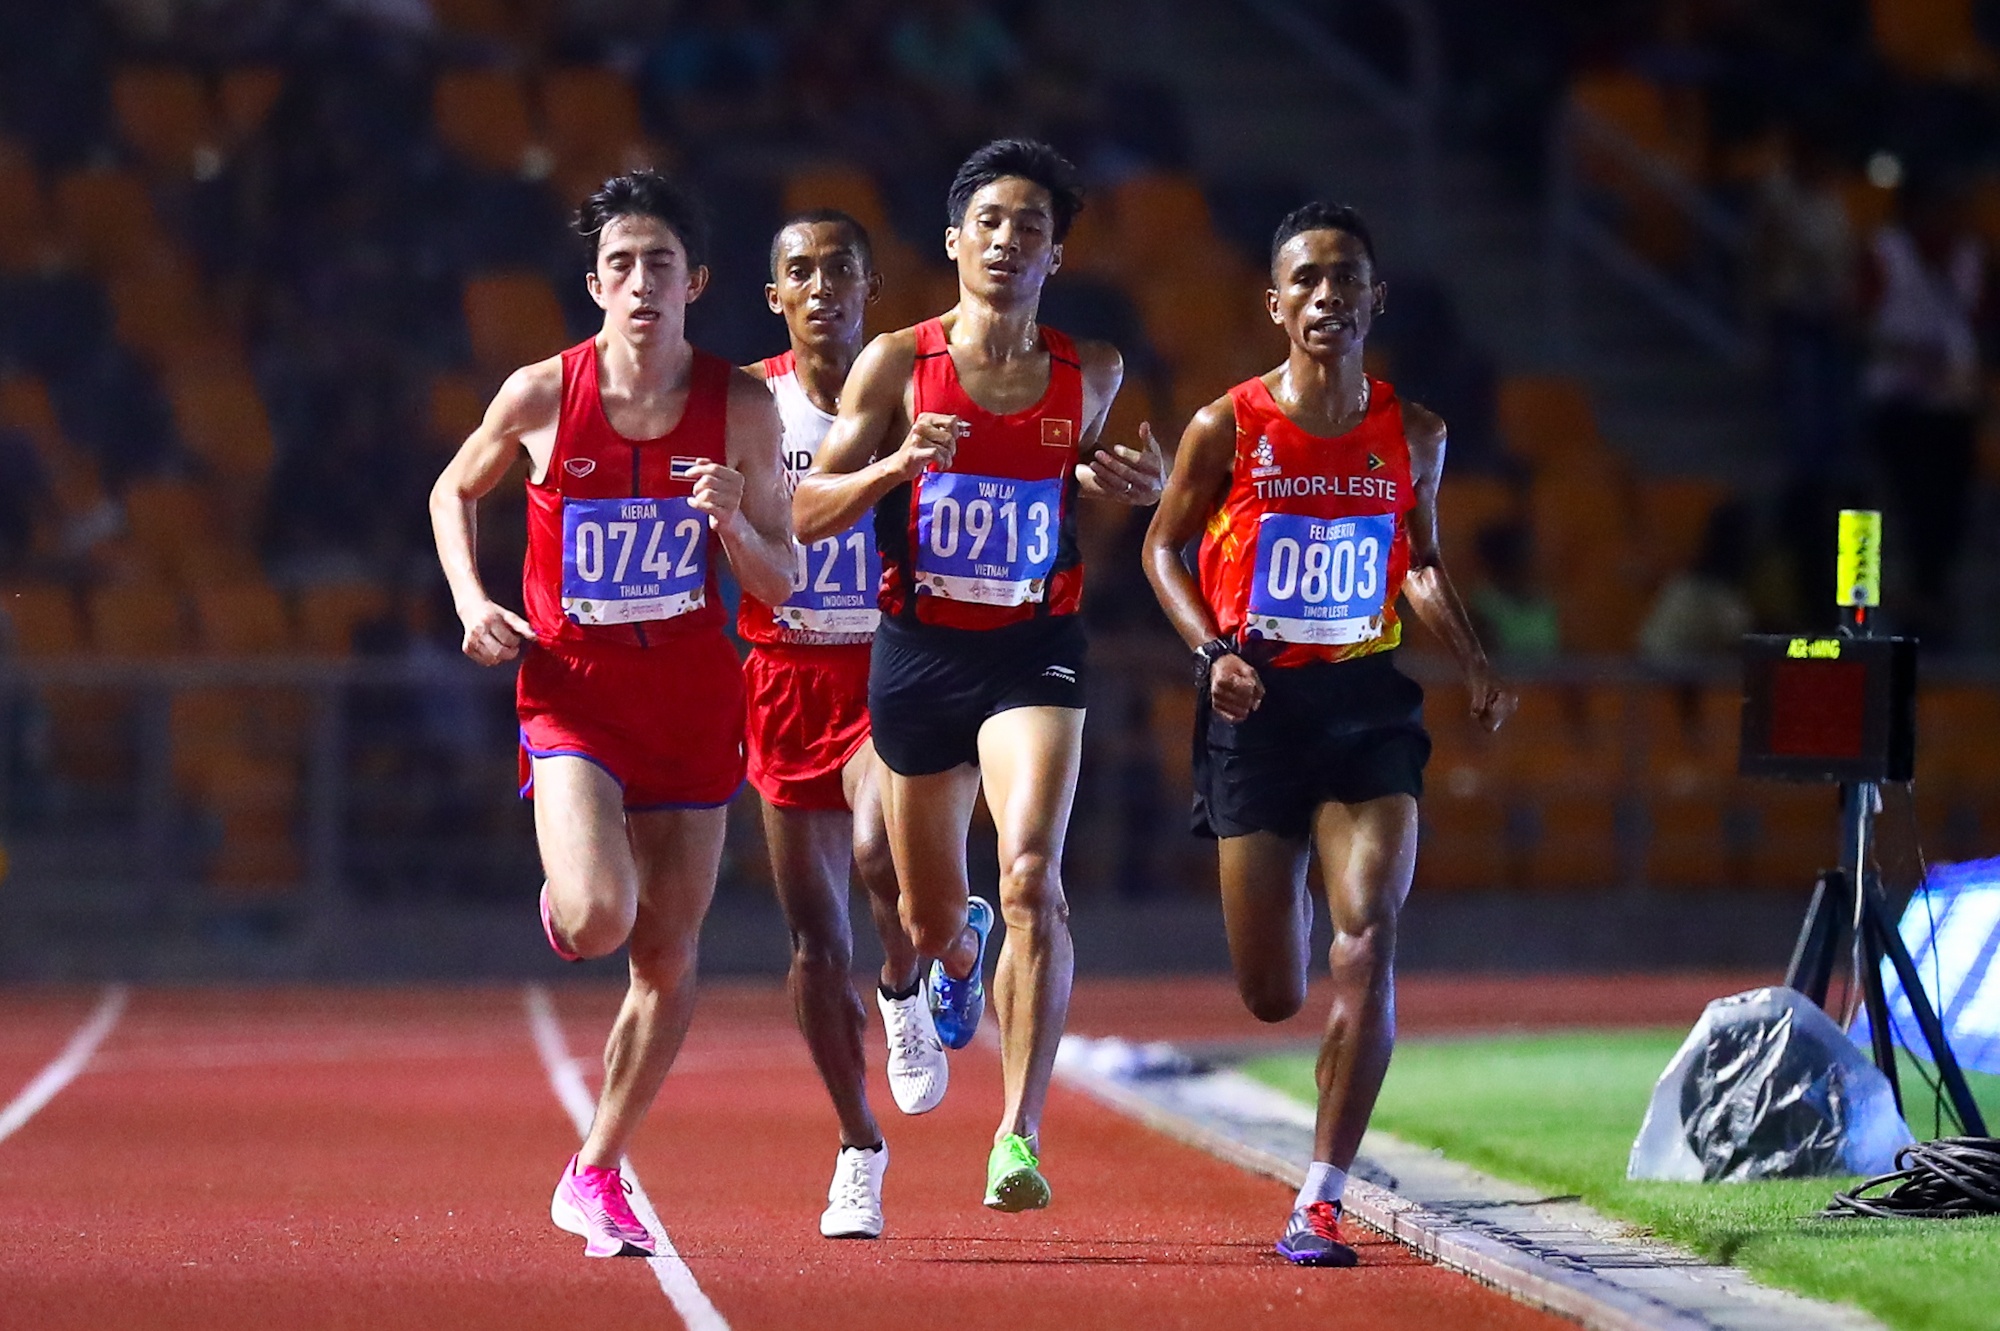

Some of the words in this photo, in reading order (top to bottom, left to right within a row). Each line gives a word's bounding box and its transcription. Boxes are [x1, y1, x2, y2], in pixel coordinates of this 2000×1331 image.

[978, 482, 998, 498] VAN
[1252, 477, 1397, 501] TIMOR-LESTE
[621, 504, 657, 519] KIERAN
[930, 497, 1050, 565] 0913
[1309, 522, 1356, 541] FELISBERTO
[575, 518, 702, 583] 0742
[974, 563, 1009, 578] VIETNAM
[1267, 537, 1379, 604] 0803
[620, 584, 660, 598] THAILAND
[822, 595, 865, 608] INDONESIA
[1303, 605, 1328, 618] TIMOR
[1328, 604, 1349, 619] LESTE
